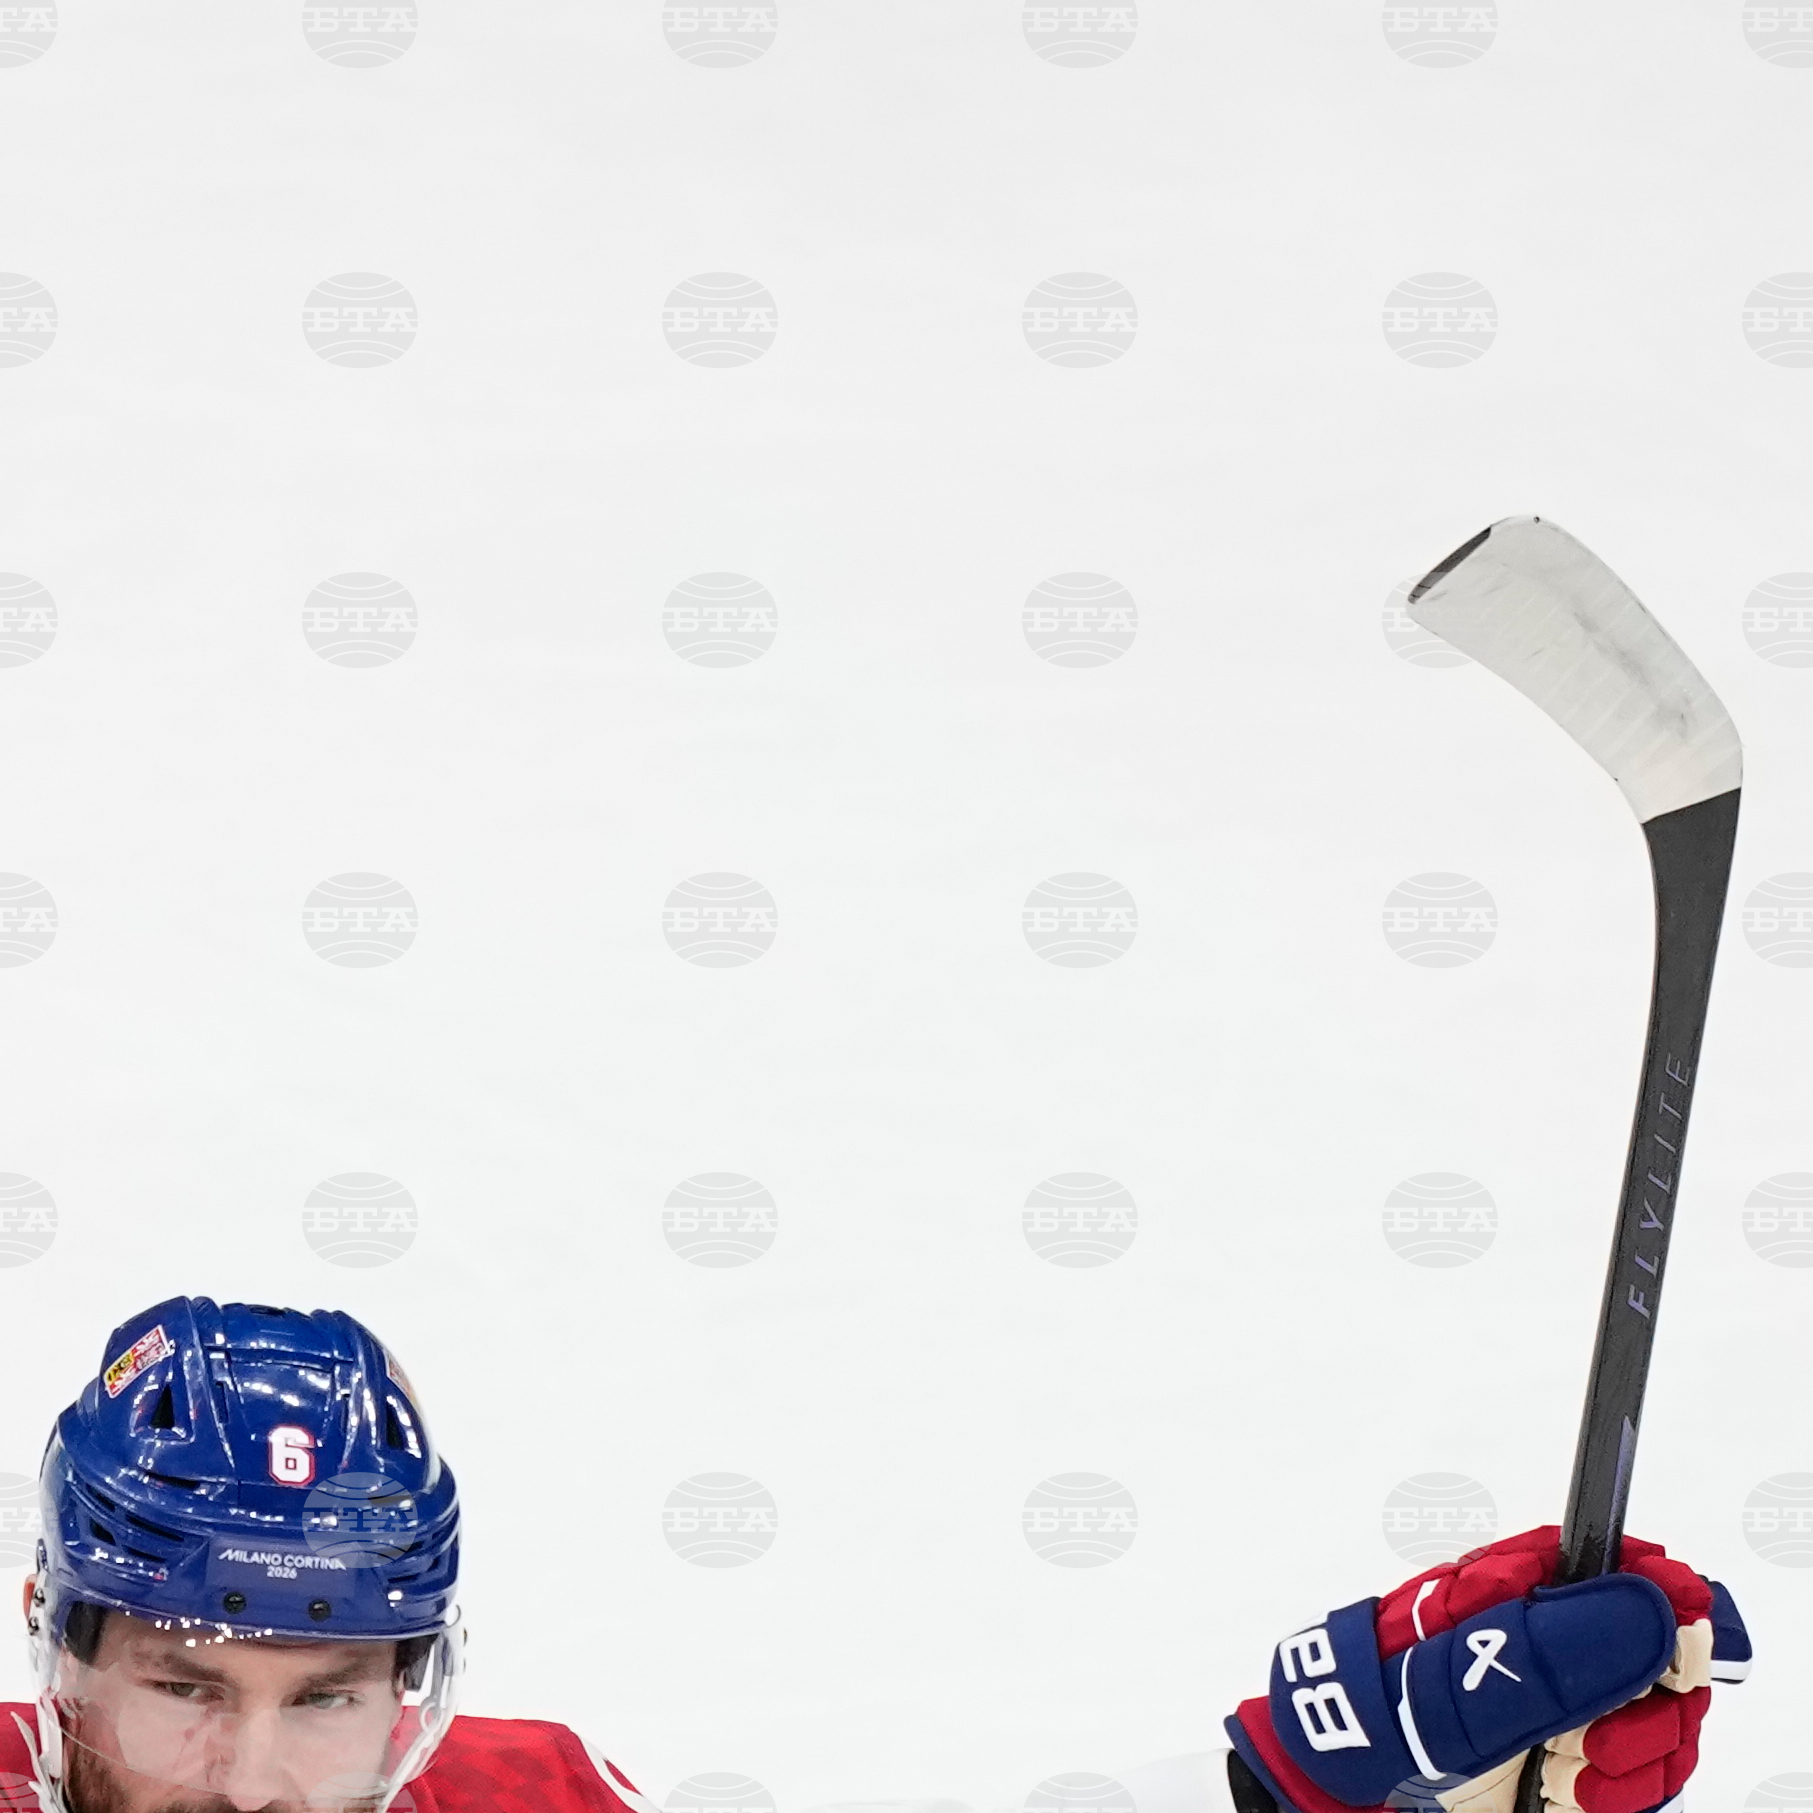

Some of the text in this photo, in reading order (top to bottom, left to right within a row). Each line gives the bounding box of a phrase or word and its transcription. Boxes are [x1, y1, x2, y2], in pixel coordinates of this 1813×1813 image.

[1627, 1053, 1688, 1320] FLYLITE
[269, 1426, 315, 1486] 6
[218, 1548, 347, 1571] MILANO CORTINA
[267, 1565, 298, 1579] 2026
